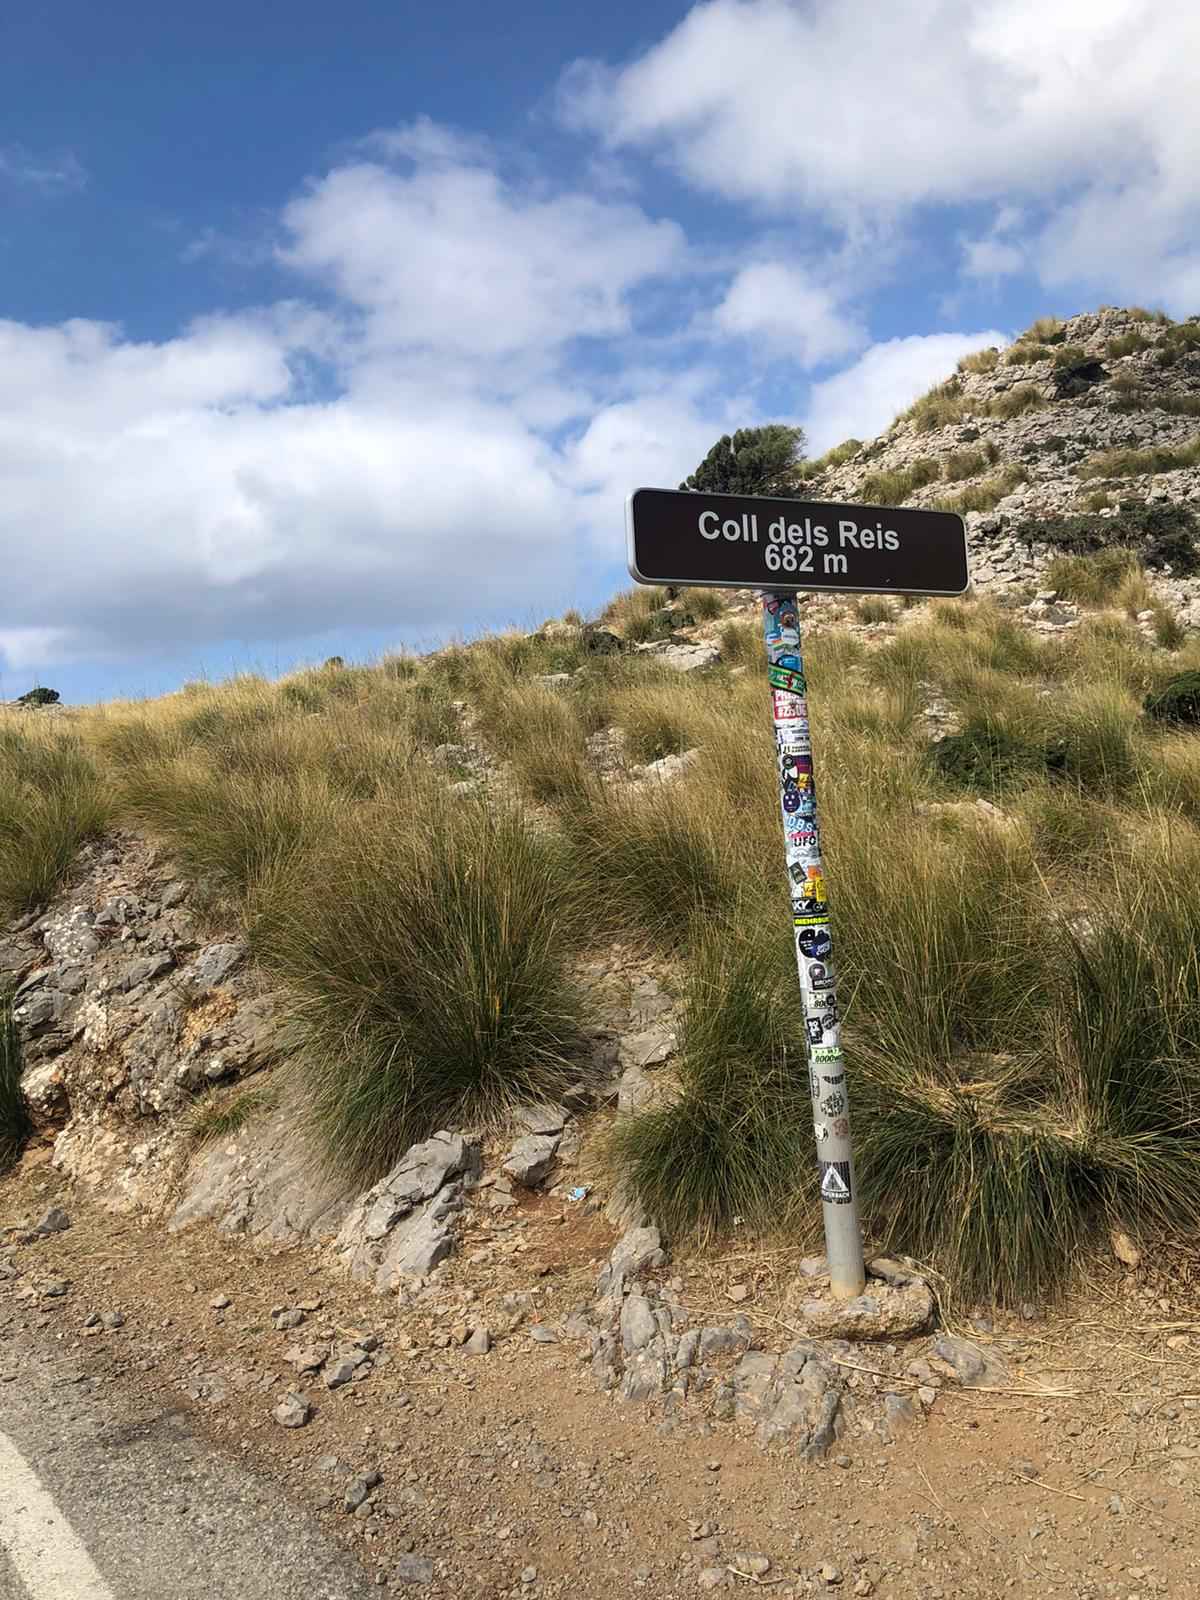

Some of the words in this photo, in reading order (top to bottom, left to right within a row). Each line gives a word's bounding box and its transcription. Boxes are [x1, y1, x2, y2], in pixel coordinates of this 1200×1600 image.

[699, 511, 758, 542] Coll
[768, 517, 829, 547] dels
[839, 521, 900, 550] Reis
[765, 544, 814, 573] 682
[823, 553, 848, 573] m
[793, 835, 817, 847] UFO
